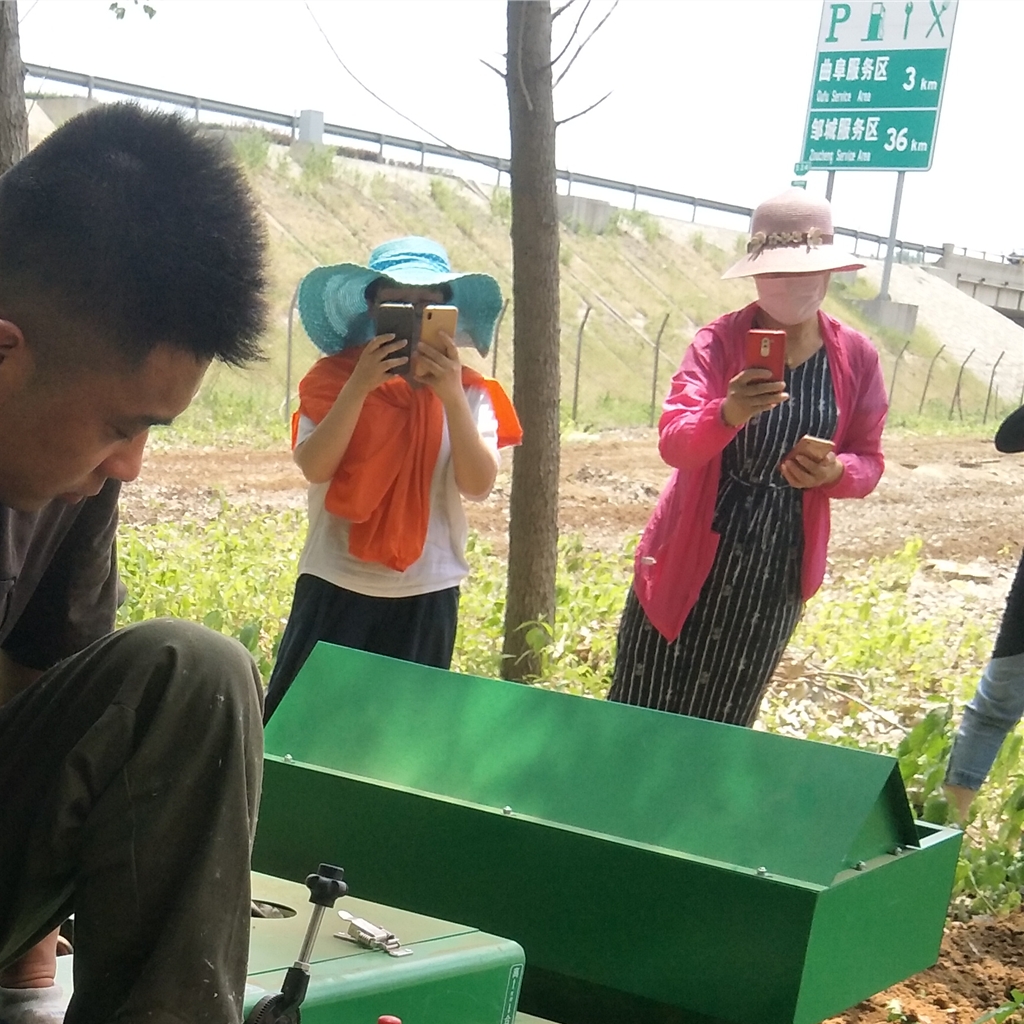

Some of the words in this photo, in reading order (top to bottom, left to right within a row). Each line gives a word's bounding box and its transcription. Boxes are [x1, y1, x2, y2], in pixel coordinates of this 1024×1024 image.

[818, 56, 890, 82] 曲阜服务区
[902, 66, 917, 91] 3
[920, 78, 938, 91] km
[831, 90, 852, 102] Service
[857, 90, 871, 102] Area
[810, 116, 881, 141] 邹城服务区
[883, 127, 909, 152] 36
[911, 139, 928, 152] km
[836, 149, 856, 162] Service
[857, 149, 872, 162] Area
